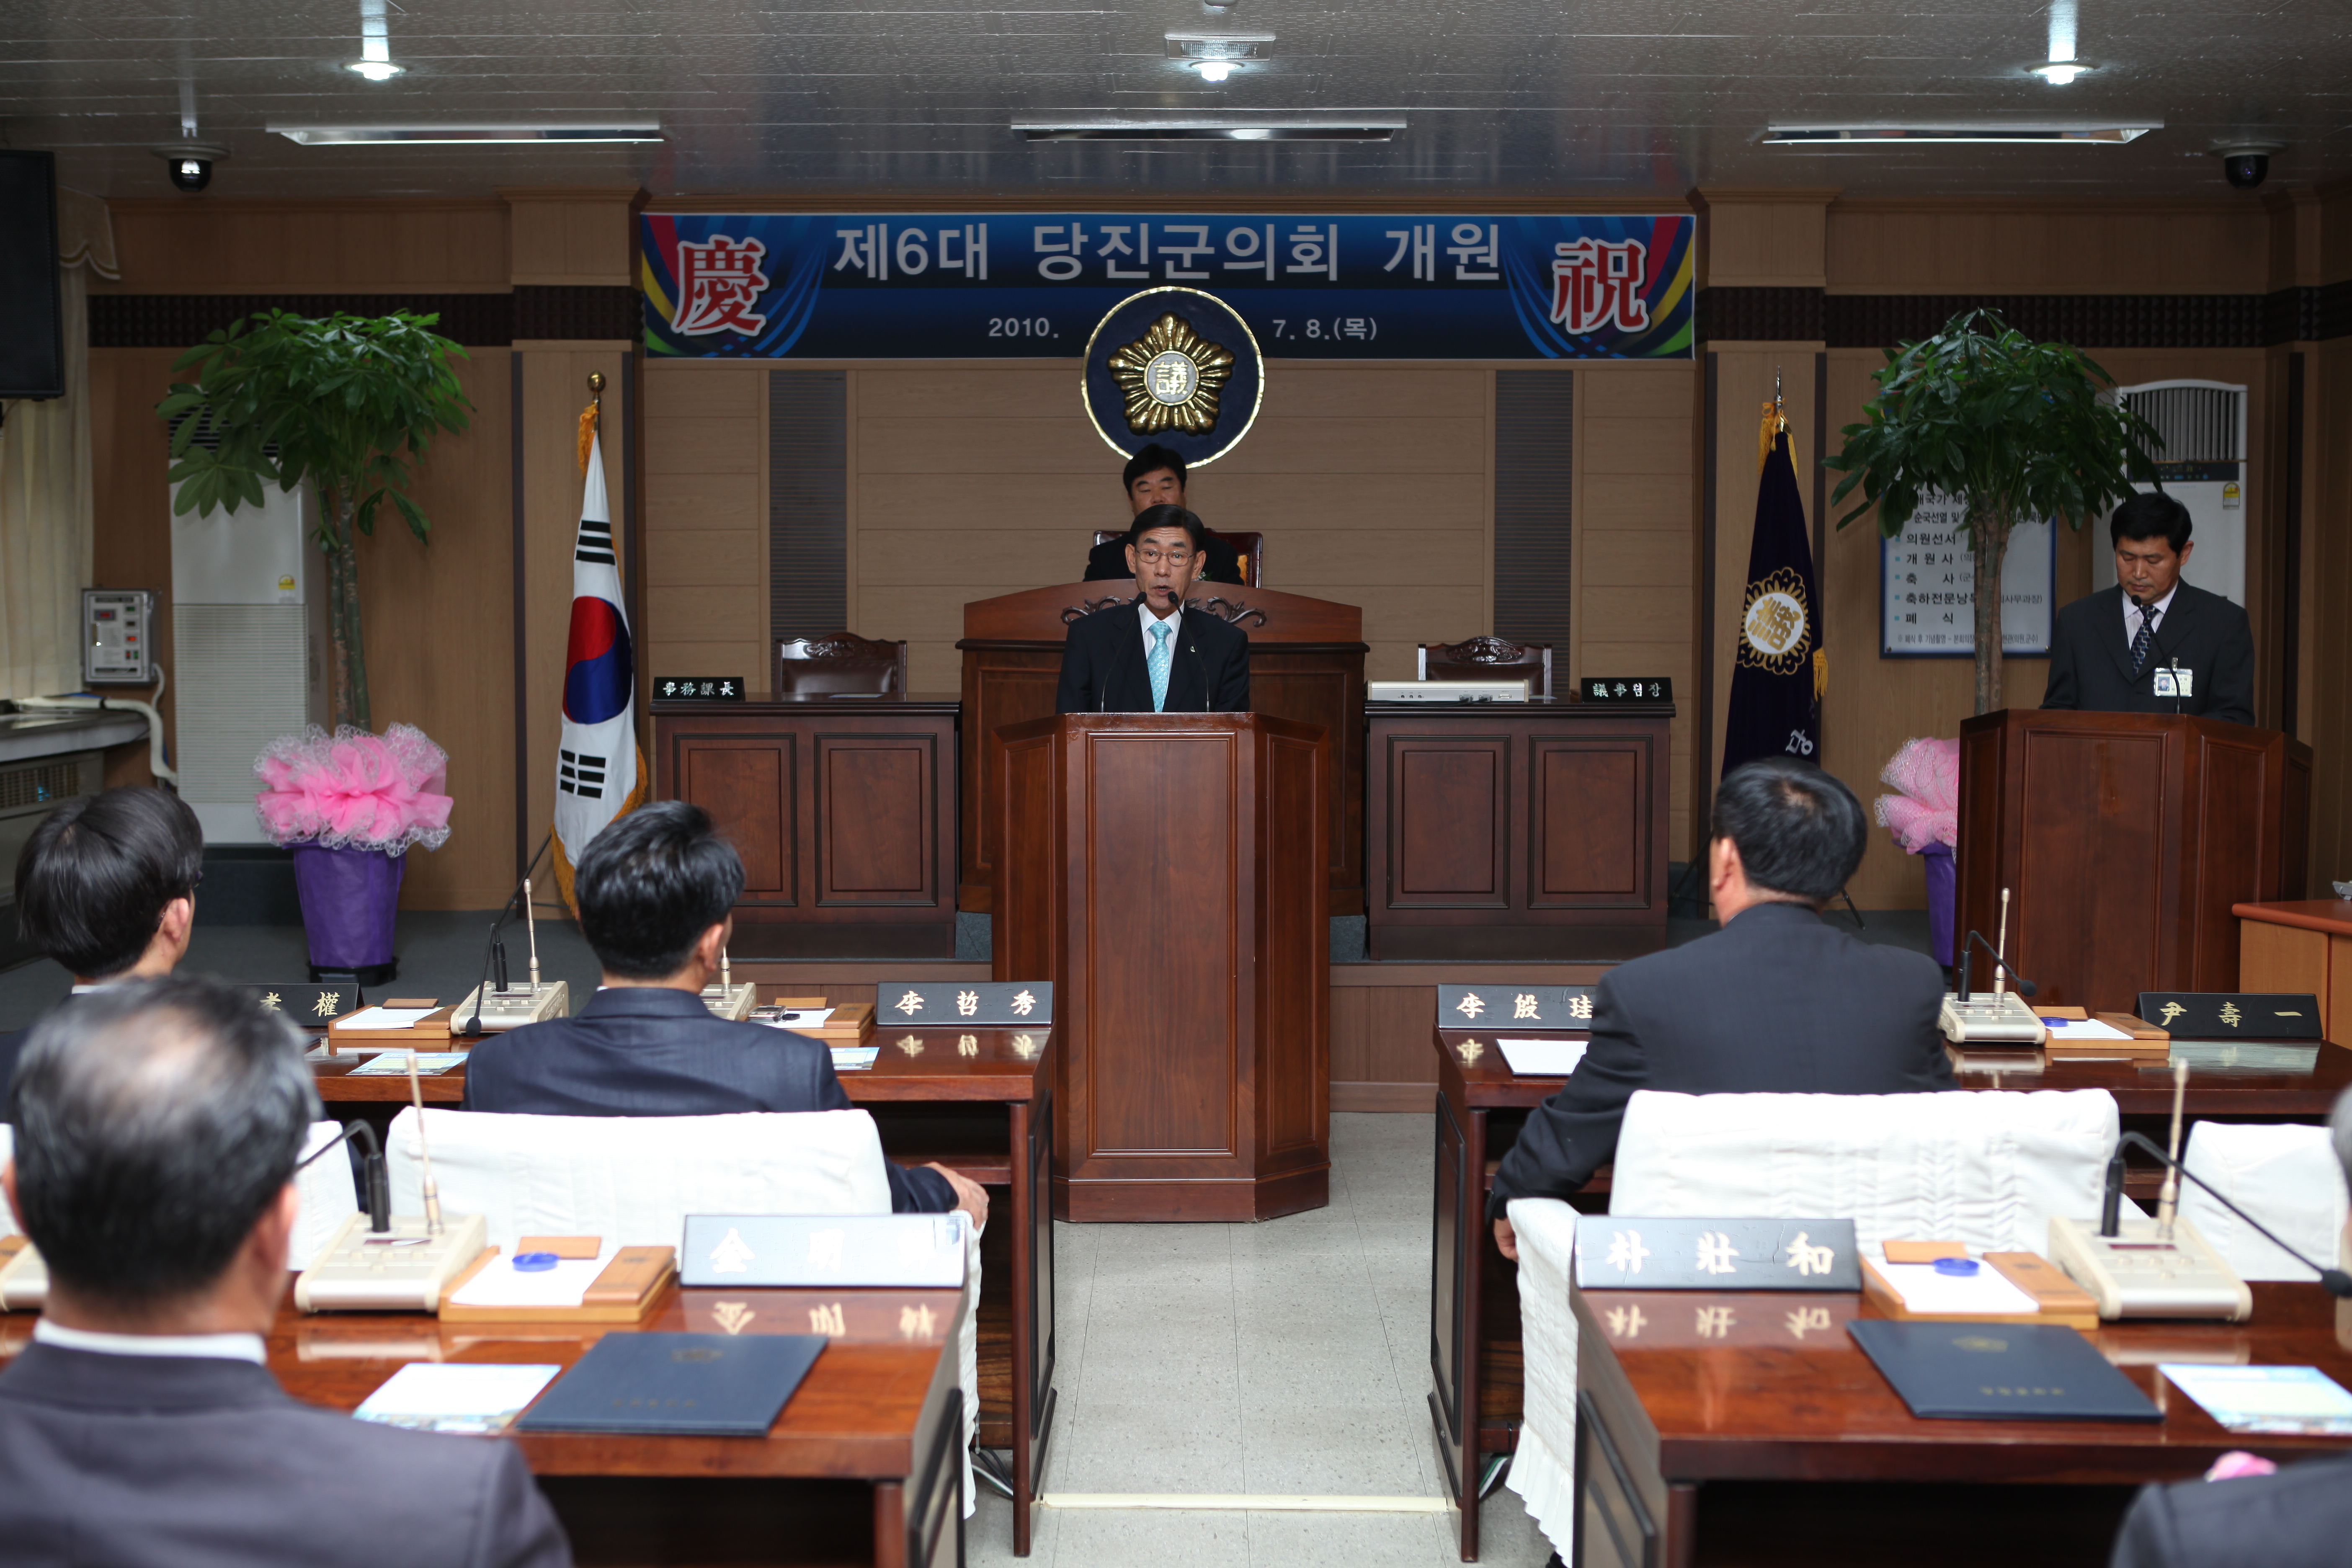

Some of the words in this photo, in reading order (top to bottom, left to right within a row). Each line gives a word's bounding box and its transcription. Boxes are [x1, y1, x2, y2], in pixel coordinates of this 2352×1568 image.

[834, 222, 988, 281] 제6대
[1033, 222, 1339, 281] 당진군의회
[1384, 222, 1500, 281] 개원
[673, 237, 767, 334] 慶
[1552, 239, 1648, 332] 祝
[989, 317, 1059, 338] 2010.
[1953, 494, 1969, 505] 제
[1914, 512, 1947, 524] 순국선열
[1952, 512, 1959, 524] 및
[1906, 533, 1956, 545] 의원선서
[894, 989, 1037, 1016] 李哲秀
[2159, 1001, 2303, 1028] 尹壽一
